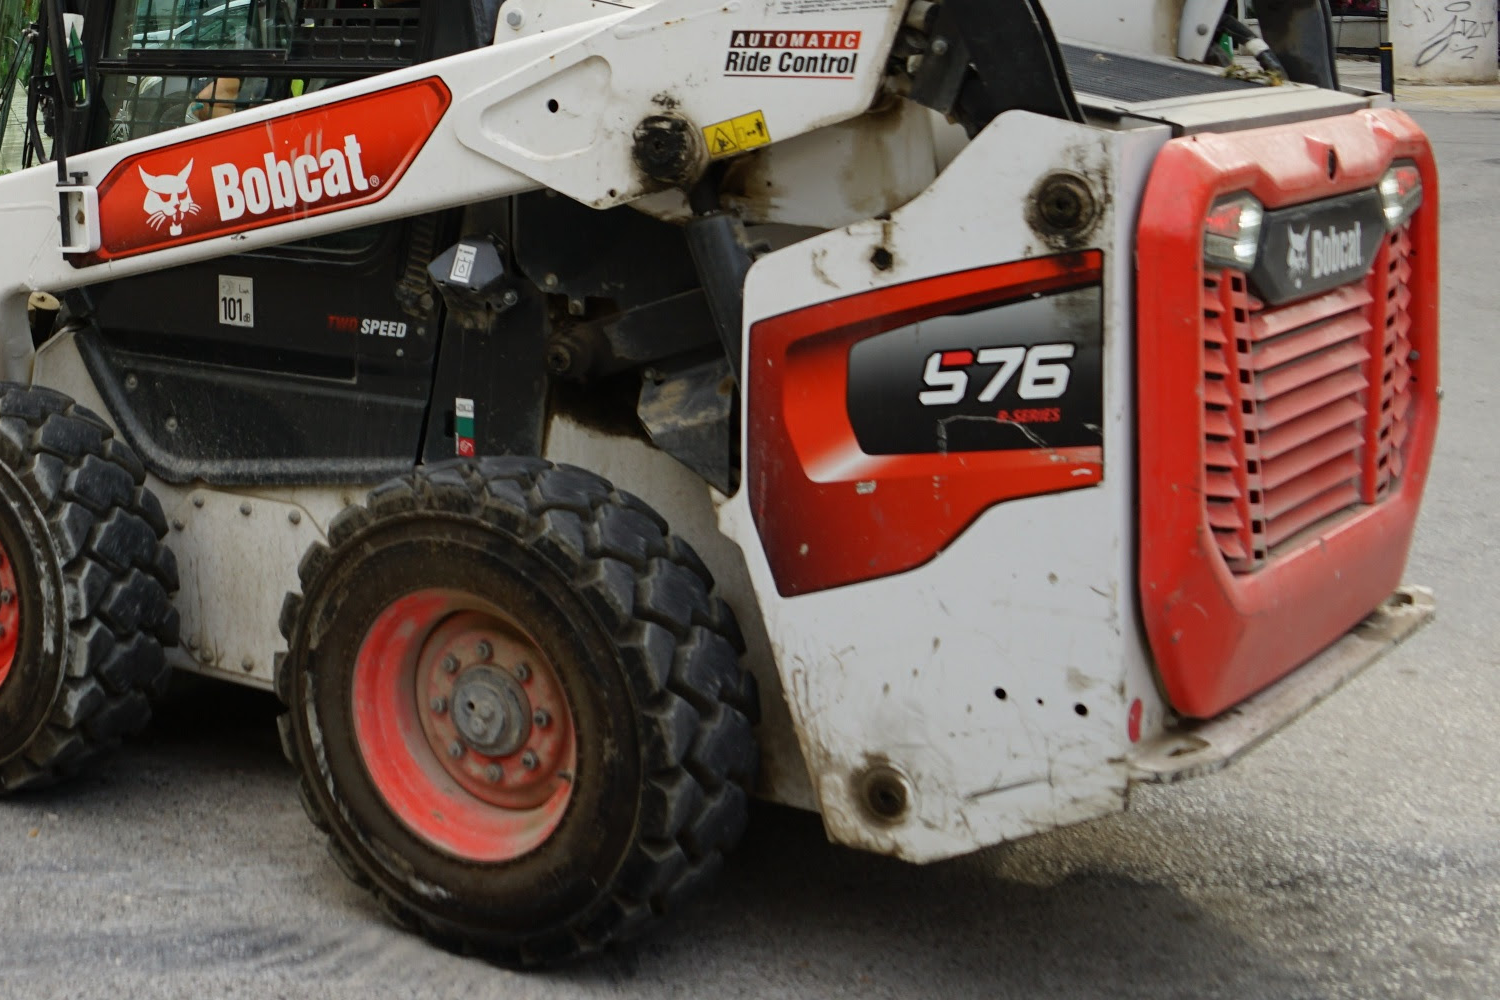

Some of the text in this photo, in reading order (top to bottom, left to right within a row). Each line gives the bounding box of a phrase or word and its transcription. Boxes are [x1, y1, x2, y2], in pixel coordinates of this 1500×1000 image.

[733, 32, 858, 48] AUTOMATIC
[724, 51, 858, 74] Ride Control
[1311, 221, 1361, 279] Bobcat
[221, 296, 243, 322] 101
[361, 318, 407, 338] SPEED
[918, 344, 1075, 406] S76
